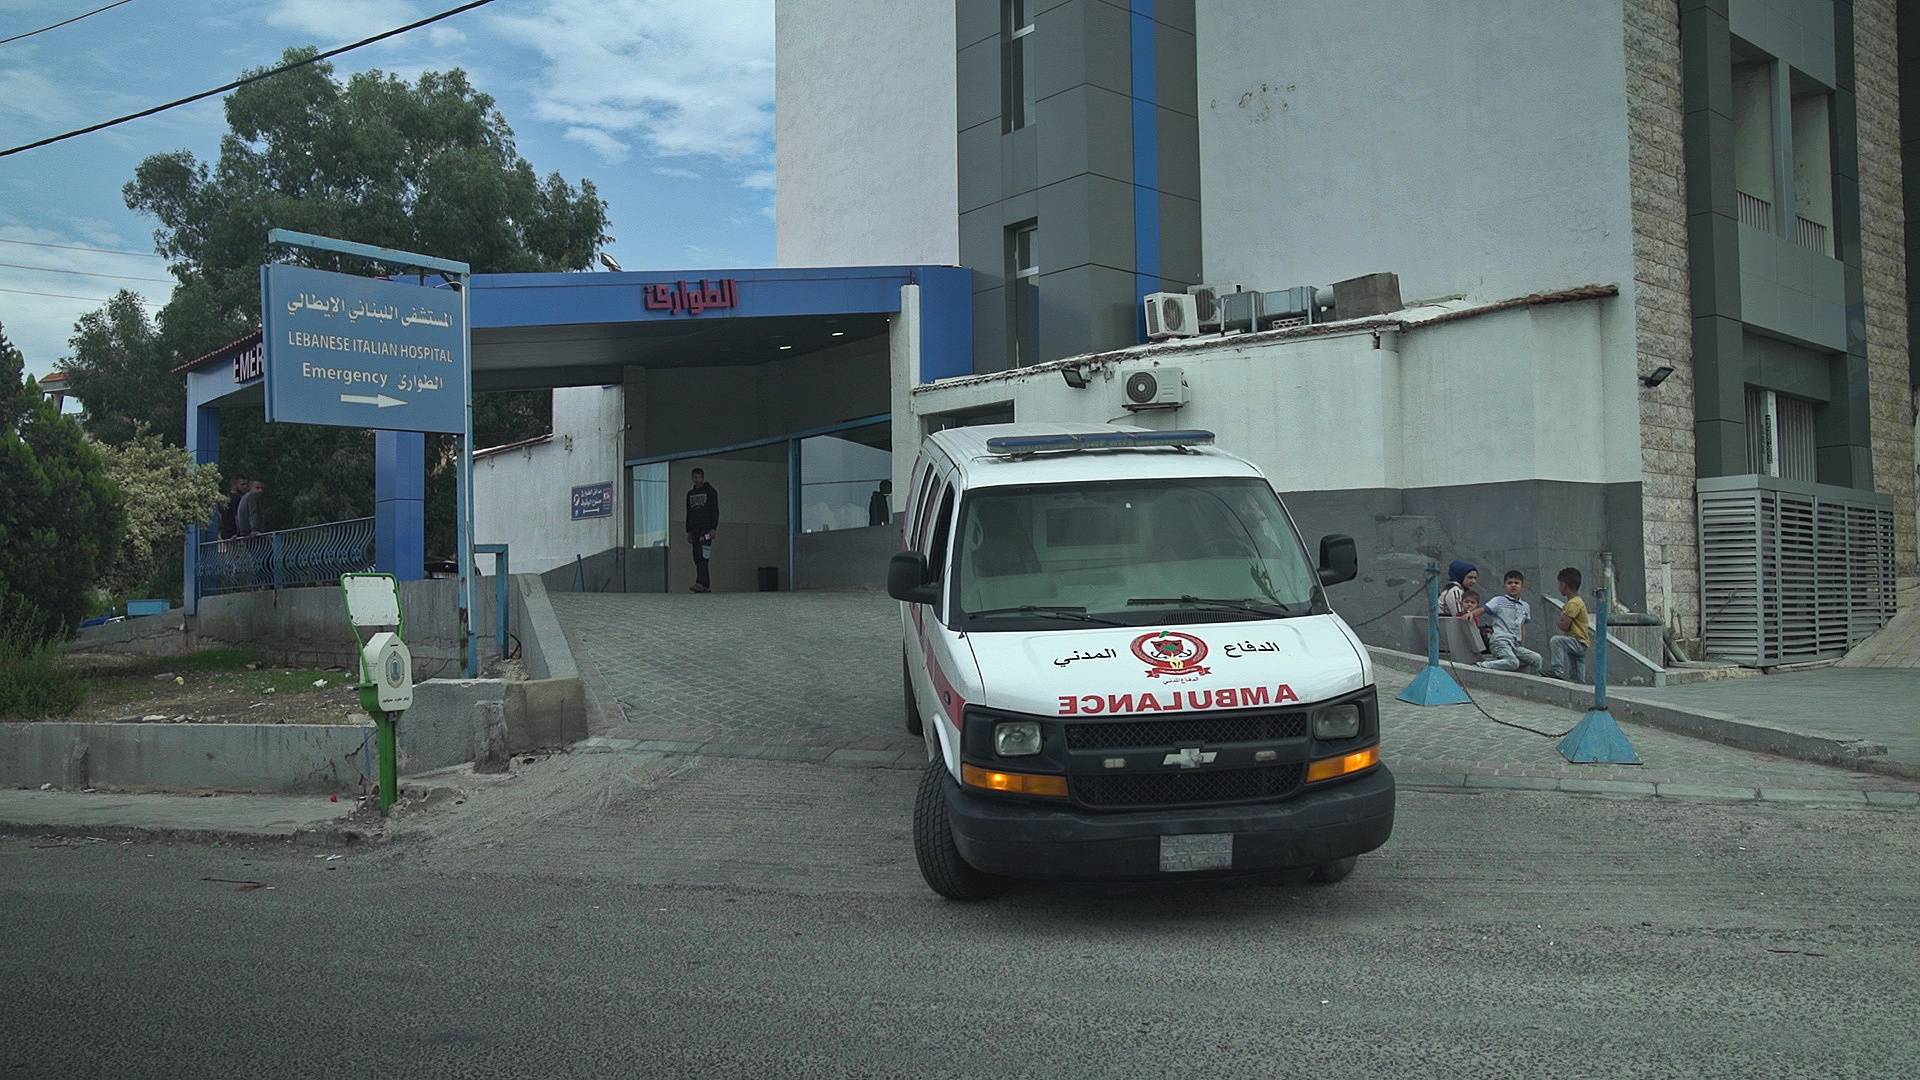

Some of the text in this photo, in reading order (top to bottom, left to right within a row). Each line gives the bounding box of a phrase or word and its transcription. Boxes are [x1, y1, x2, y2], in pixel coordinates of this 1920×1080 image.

[349, 300, 398, 324] اللبناني
[401, 307, 453, 328] المستشفى
[288, 331, 453, 363] LEBANESE ITALIAN HOSPITAL
[302, 362, 388, 387] Emergency
[1053, 640, 1281, 668] الدفاع المدني
